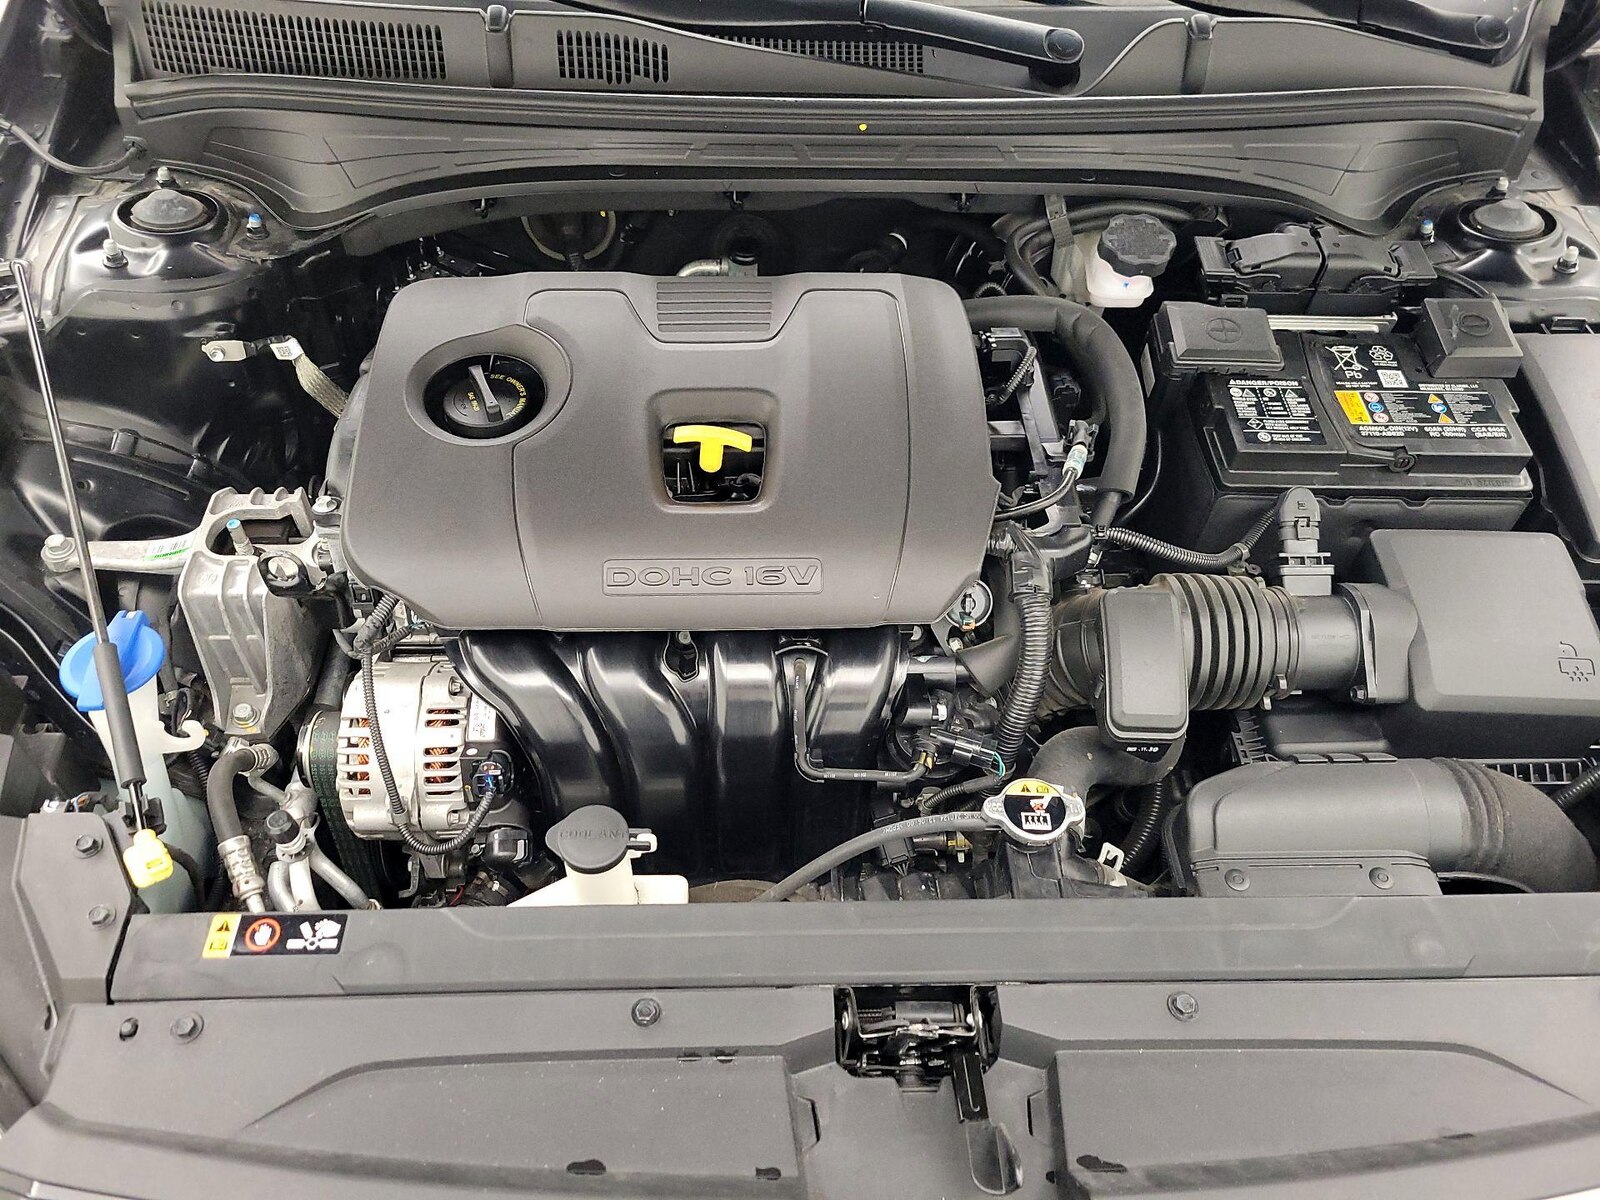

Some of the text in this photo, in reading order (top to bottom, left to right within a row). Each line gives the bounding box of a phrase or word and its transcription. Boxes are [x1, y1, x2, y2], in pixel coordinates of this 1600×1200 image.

[1344, 370, 1363, 379] Pb
[490, 373, 528, 418] SEE OWNER'S MANUAL
[606, 565, 818, 587] DOHC 16V
[560, 829, 626, 839] COOLANT
